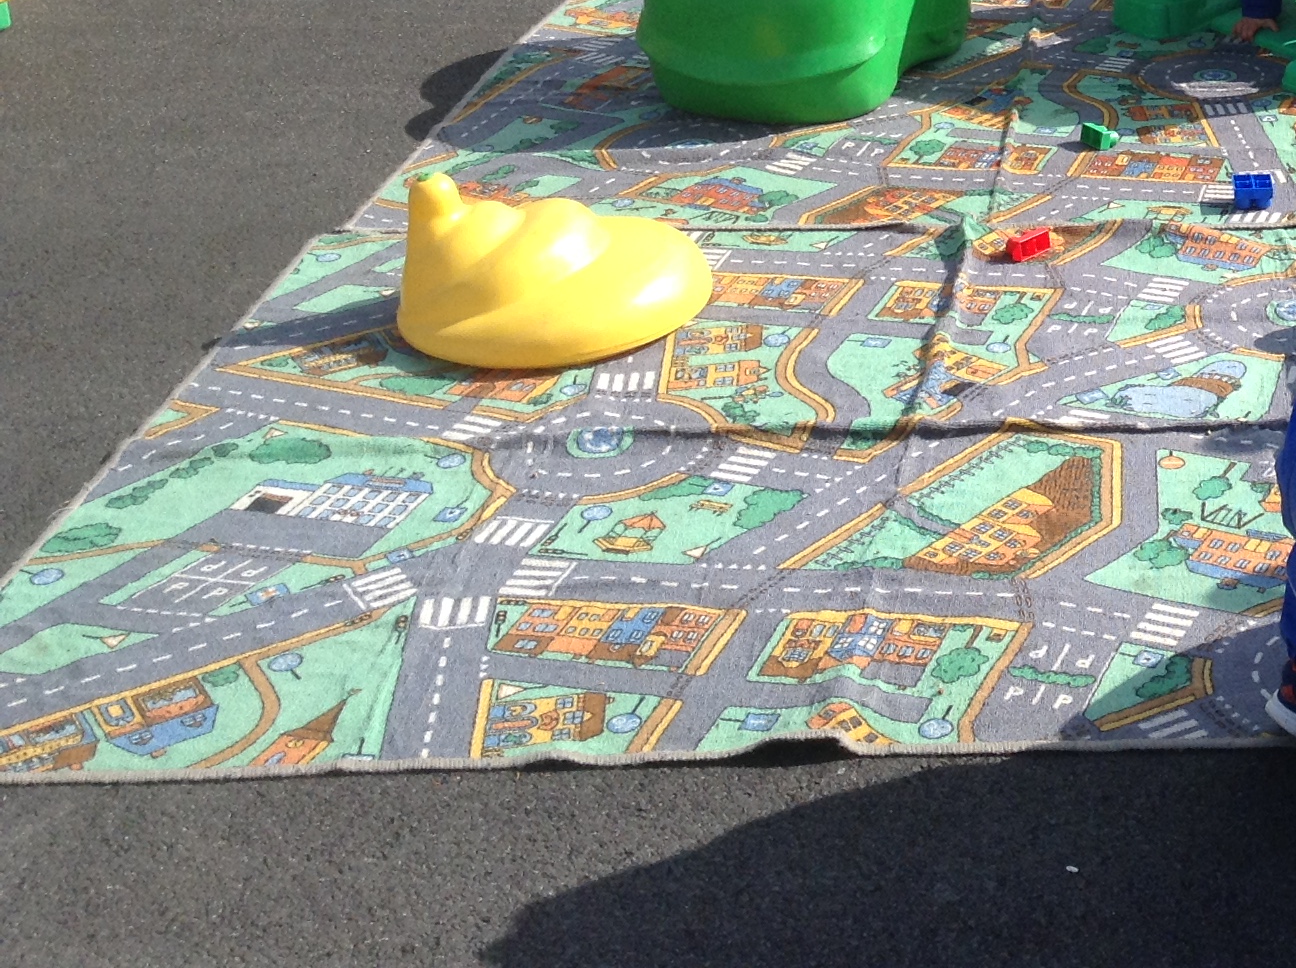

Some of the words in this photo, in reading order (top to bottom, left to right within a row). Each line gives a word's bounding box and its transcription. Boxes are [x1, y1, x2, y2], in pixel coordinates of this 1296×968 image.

[162, 581, 190, 594] P
[201, 586, 229, 599] P
[1003, 685, 1024, 701] P
[1051, 693, 1073, 710] P
